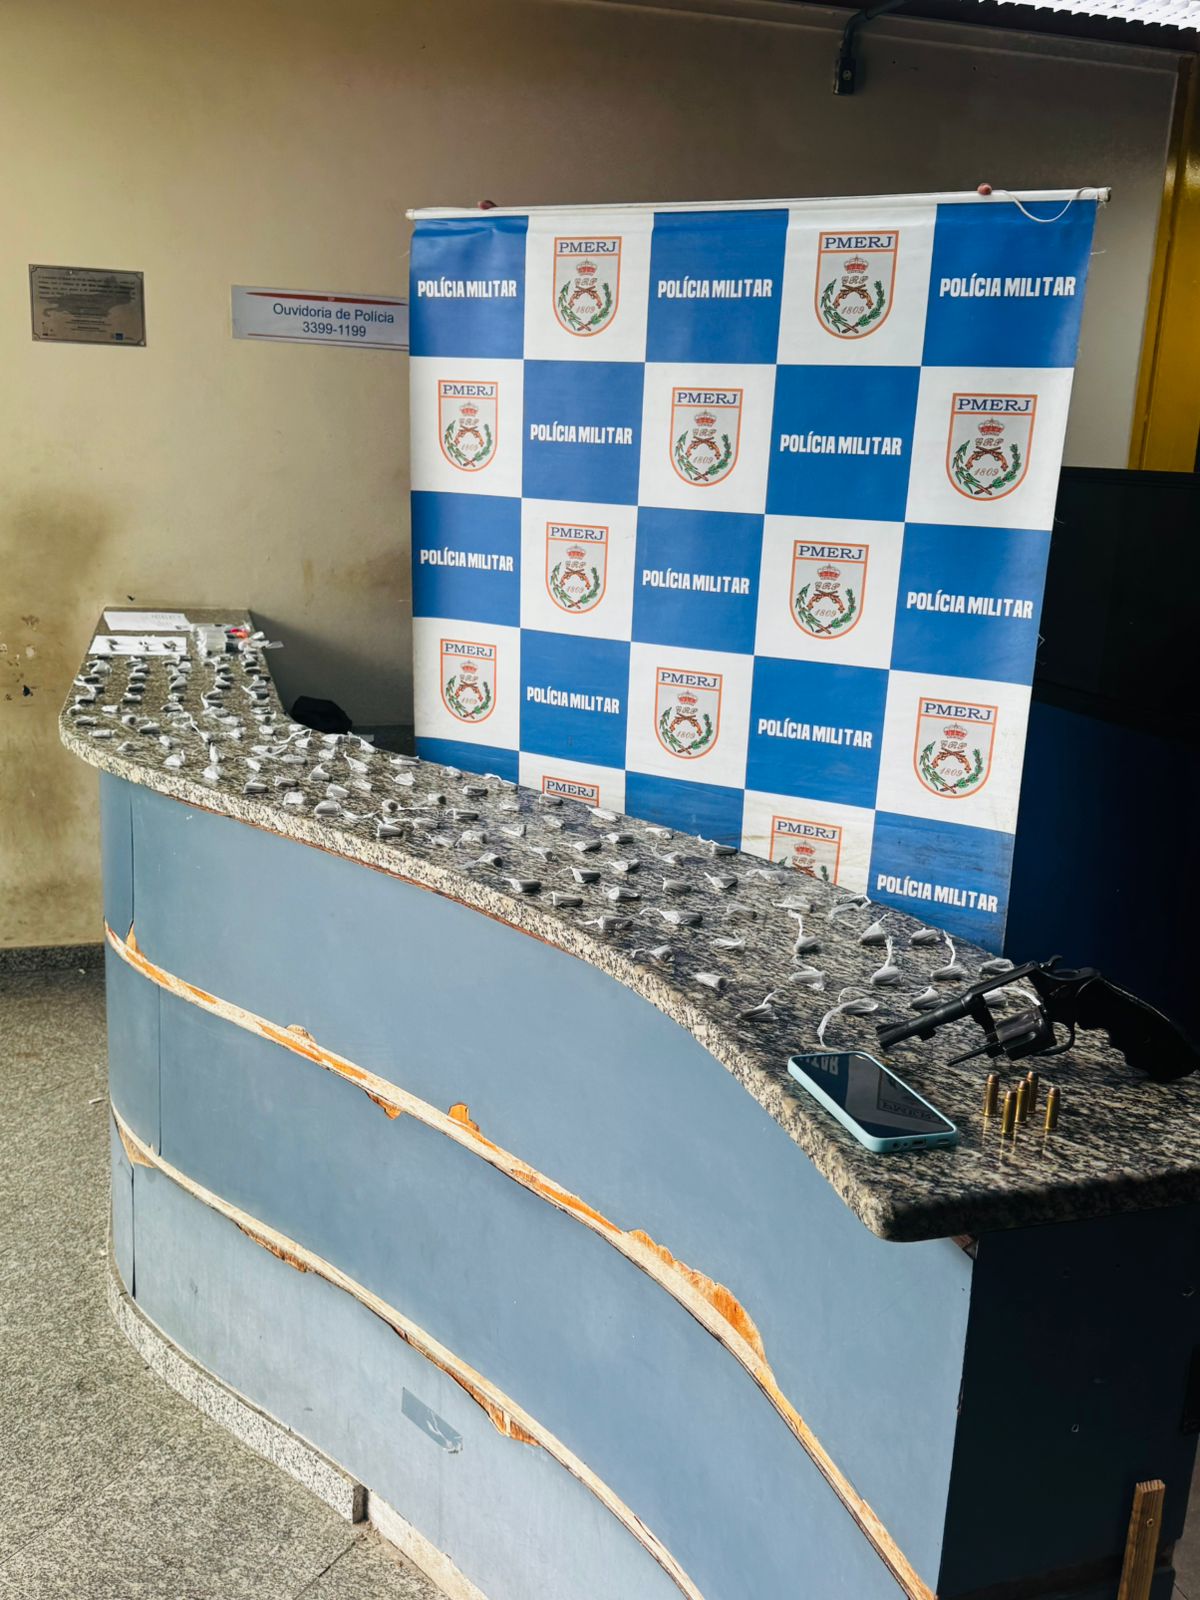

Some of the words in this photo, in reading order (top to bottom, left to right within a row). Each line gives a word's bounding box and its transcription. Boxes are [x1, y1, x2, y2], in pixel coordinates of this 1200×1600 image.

[559, 241, 616, 253] PMERJ
[824, 236, 892, 249] PMERJ
[418, 277, 465, 297] POLÍCIA
[466, 280, 516, 298] MILITAR
[658, 276, 709, 298] POLÍCIA
[712, 280, 772, 297] MILITAR
[940, 274, 999, 297] POLÍCIA
[1004, 277, 1075, 296] MILITAR
[273, 303, 331, 319] Ouvidoria
[335, 307, 350, 320] de
[354, 309, 394, 323] Polícia
[842, 306, 864, 314] 1809
[303, 322, 366, 337] 3399-1199
[443, 384, 494, 396] PMERJ
[677, 393, 738, 404] PMERJ
[958, 398, 1031, 411] PMERJ
[530, 421, 576, 442] POLÍCIA
[578, 426, 632, 444] MILITAR
[780, 432, 835, 453] POLÍCIA
[838, 437, 901, 455] MILITAR
[693, 456, 713, 464] 1809
[974, 468, 999, 477] 1809
[551, 527, 604, 540] PMERJ
[421, 547, 466, 567] POLÍCIA
[468, 553, 513, 571] MILITAR
[799, 545, 863, 559] PMERJ
[643, 568, 690, 589] POLÍCIA
[693, 575, 749, 594] MILITAR
[907, 590, 964, 613] POLÍCIA
[968, 597, 1033, 619] MILITAR
[815, 609, 836, 617] 1809
[445, 644, 492, 656] PMERJ
[661, 672, 718, 687] PMERJ
[527, 687, 568, 707] POLÍCIA
[570, 693, 619, 713] MILITAR
[924, 703, 992, 720] PMERJ
[758, 719, 810, 740] POLÍCIA
[812, 726, 872, 748] MILITAR
[940, 768, 962, 776] 1809
[547, 782, 594, 796] PMERJ
[777, 821, 837, 838] PMERJ
[877, 874, 931, 900] POLÍCIA
[934, 886, 998, 912] MILITAR
